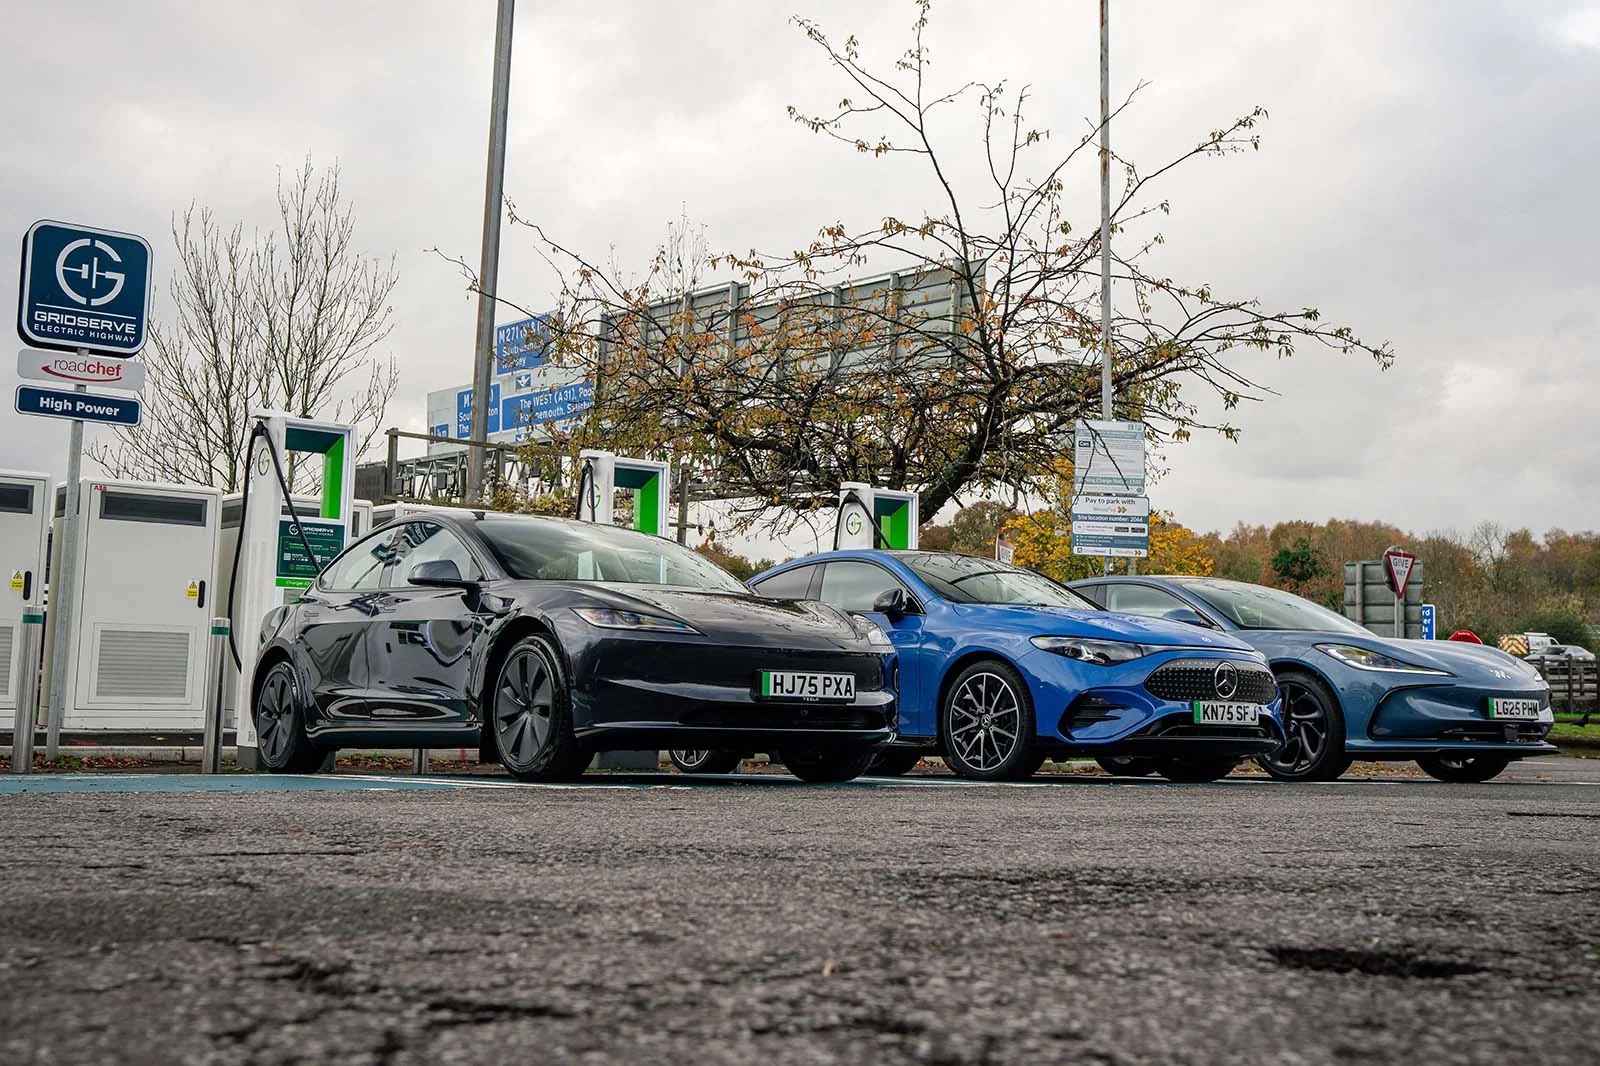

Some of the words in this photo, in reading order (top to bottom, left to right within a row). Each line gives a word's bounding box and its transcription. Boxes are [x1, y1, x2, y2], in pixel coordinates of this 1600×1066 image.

[34, 310, 137, 334] GRIDSERVE
[34, 323, 85, 337] ELECTRIC
[89, 331, 135, 343] HIGHWAY
[54, 359, 122, 377] roadchef
[40, 397, 72, 412] High
[75, 401, 120, 416] Power
[520, 400, 532, 409] The
[533, 393, 552, 407] WEST
[1392, 558, 1409, 569] GIVE
[773, 674, 818, 695] HJ75
[823, 676, 853, 696] PXA
[1202, 704, 1234, 721] KN75
[1236, 706, 1258, 721] SFJ
[1496, 701, 1520, 716] LG25
